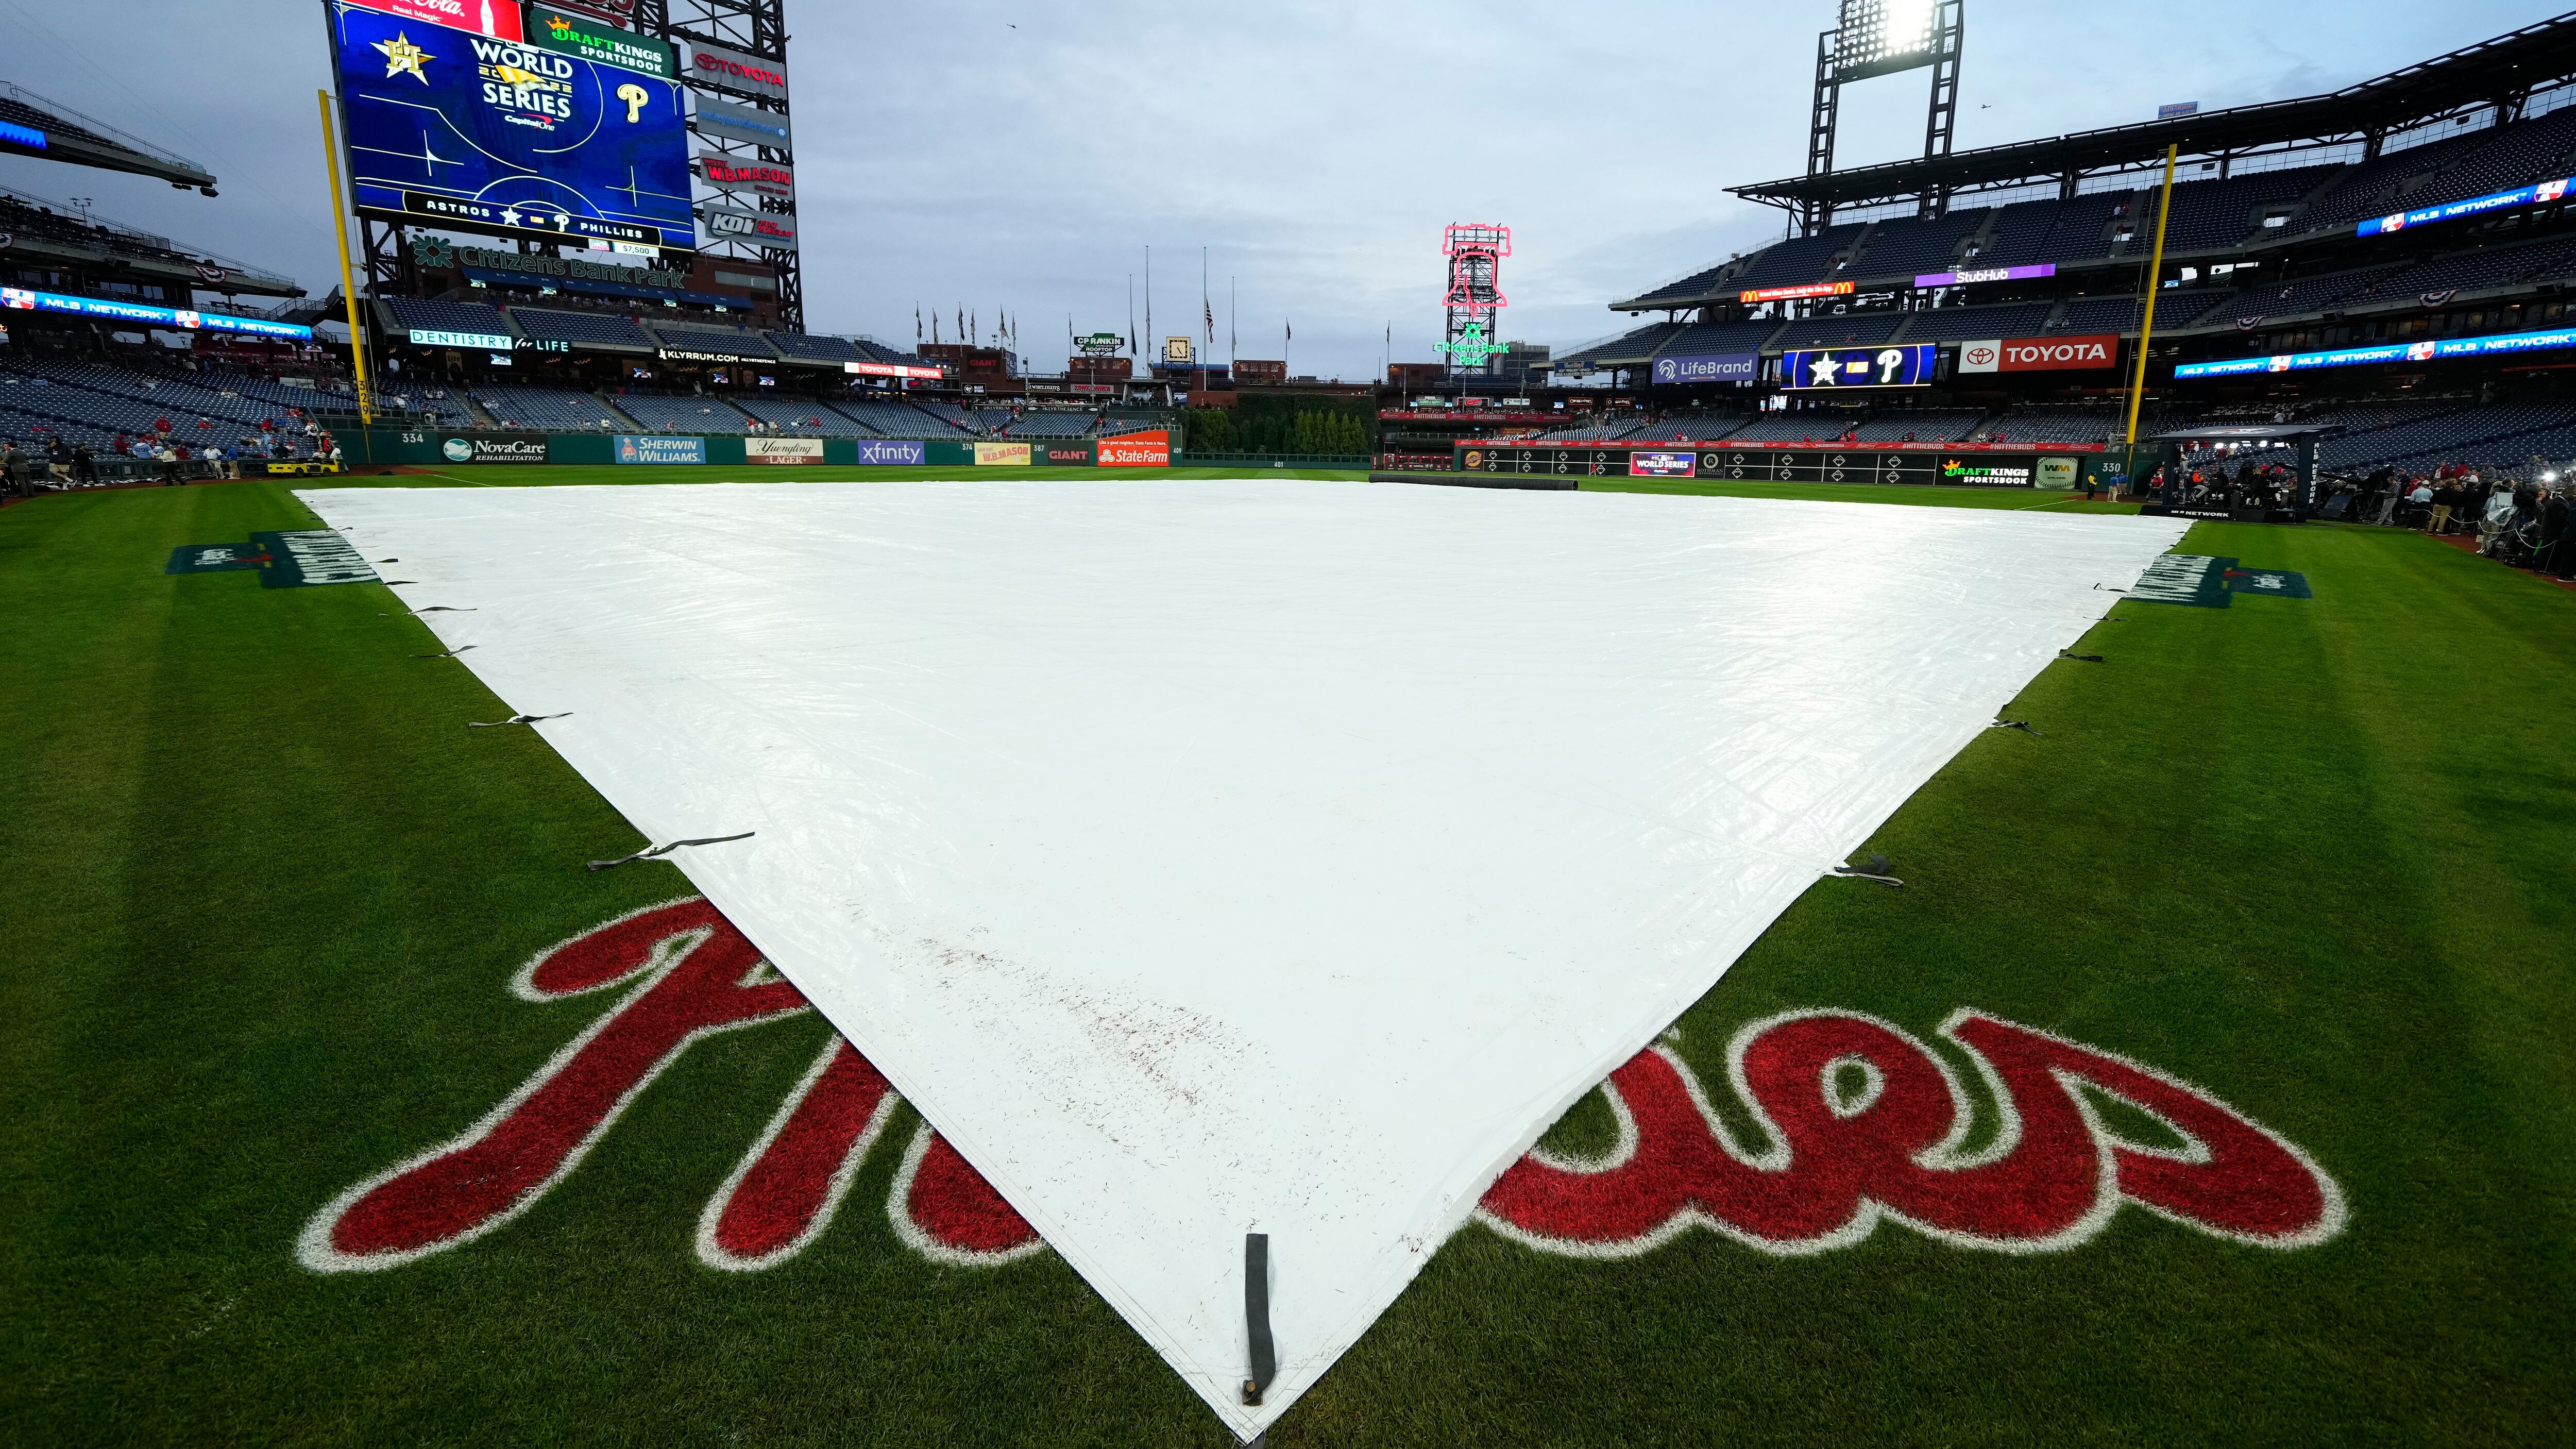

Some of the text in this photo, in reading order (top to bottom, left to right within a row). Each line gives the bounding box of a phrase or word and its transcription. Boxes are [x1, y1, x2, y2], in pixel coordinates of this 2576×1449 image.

[393, 5, 413, 15] Real
[414, 10, 441, 22] Magic
[551, 28, 663, 63] DRAFTKINGS
[470, 39, 573, 78] WORLD
[581, 46, 663, 73] SPORTSBOOK
[717, 59, 784, 87] TOYOTA
[483, 83, 571, 118] SERIES
[707, 165, 790, 186] W.B.MASON
[2410, 195, 2520, 223] MLB NETWORK
[427, 200, 490, 217] ASTROS
[581, 223, 643, 239] PHILLIES
[459, 246, 685, 289] Citizens Bank Park
[1956, 268, 2008, 283] StubHub
[45, 298, 80, 310] MLB
[207, 317, 234, 328] MLB
[412, 332, 568, 352] DENTISTRY for LIFE
[1434, 342, 1510, 353] Citizens Bank
[2443, 343, 2478, 353] MLB
[668, 351, 738, 362] KLYRRUM.COM
[1459, 355, 1483, 365] Park
[2007, 344, 2106, 362] TOYOTA
[1682, 359, 1752, 375] LifeBrand
[2297, 357, 2323, 365] MLB
[860, 365, 939, 377] TOYOTA TOYOTA
[2183, 367, 2204, 375] MLB
[359, 380, 368, 415] 329
[402, 433, 423, 443] 334
[639, 438, 697, 450] SHERWIN
[473, 440, 546, 454] NovaCare
[756, 439, 814, 454] Yuengling
[863, 443, 921, 463] xfinity
[982, 446, 1028, 462] W.B.MASON
[769, 456, 803, 464] LAGER
[1049, 450, 1088, 460] GIANT
[1945, 467, 2029, 476] DRAFTKINGS
[2102, 463, 2121, 472] 330
[2309, 464, 2318, 503] NETWORK
